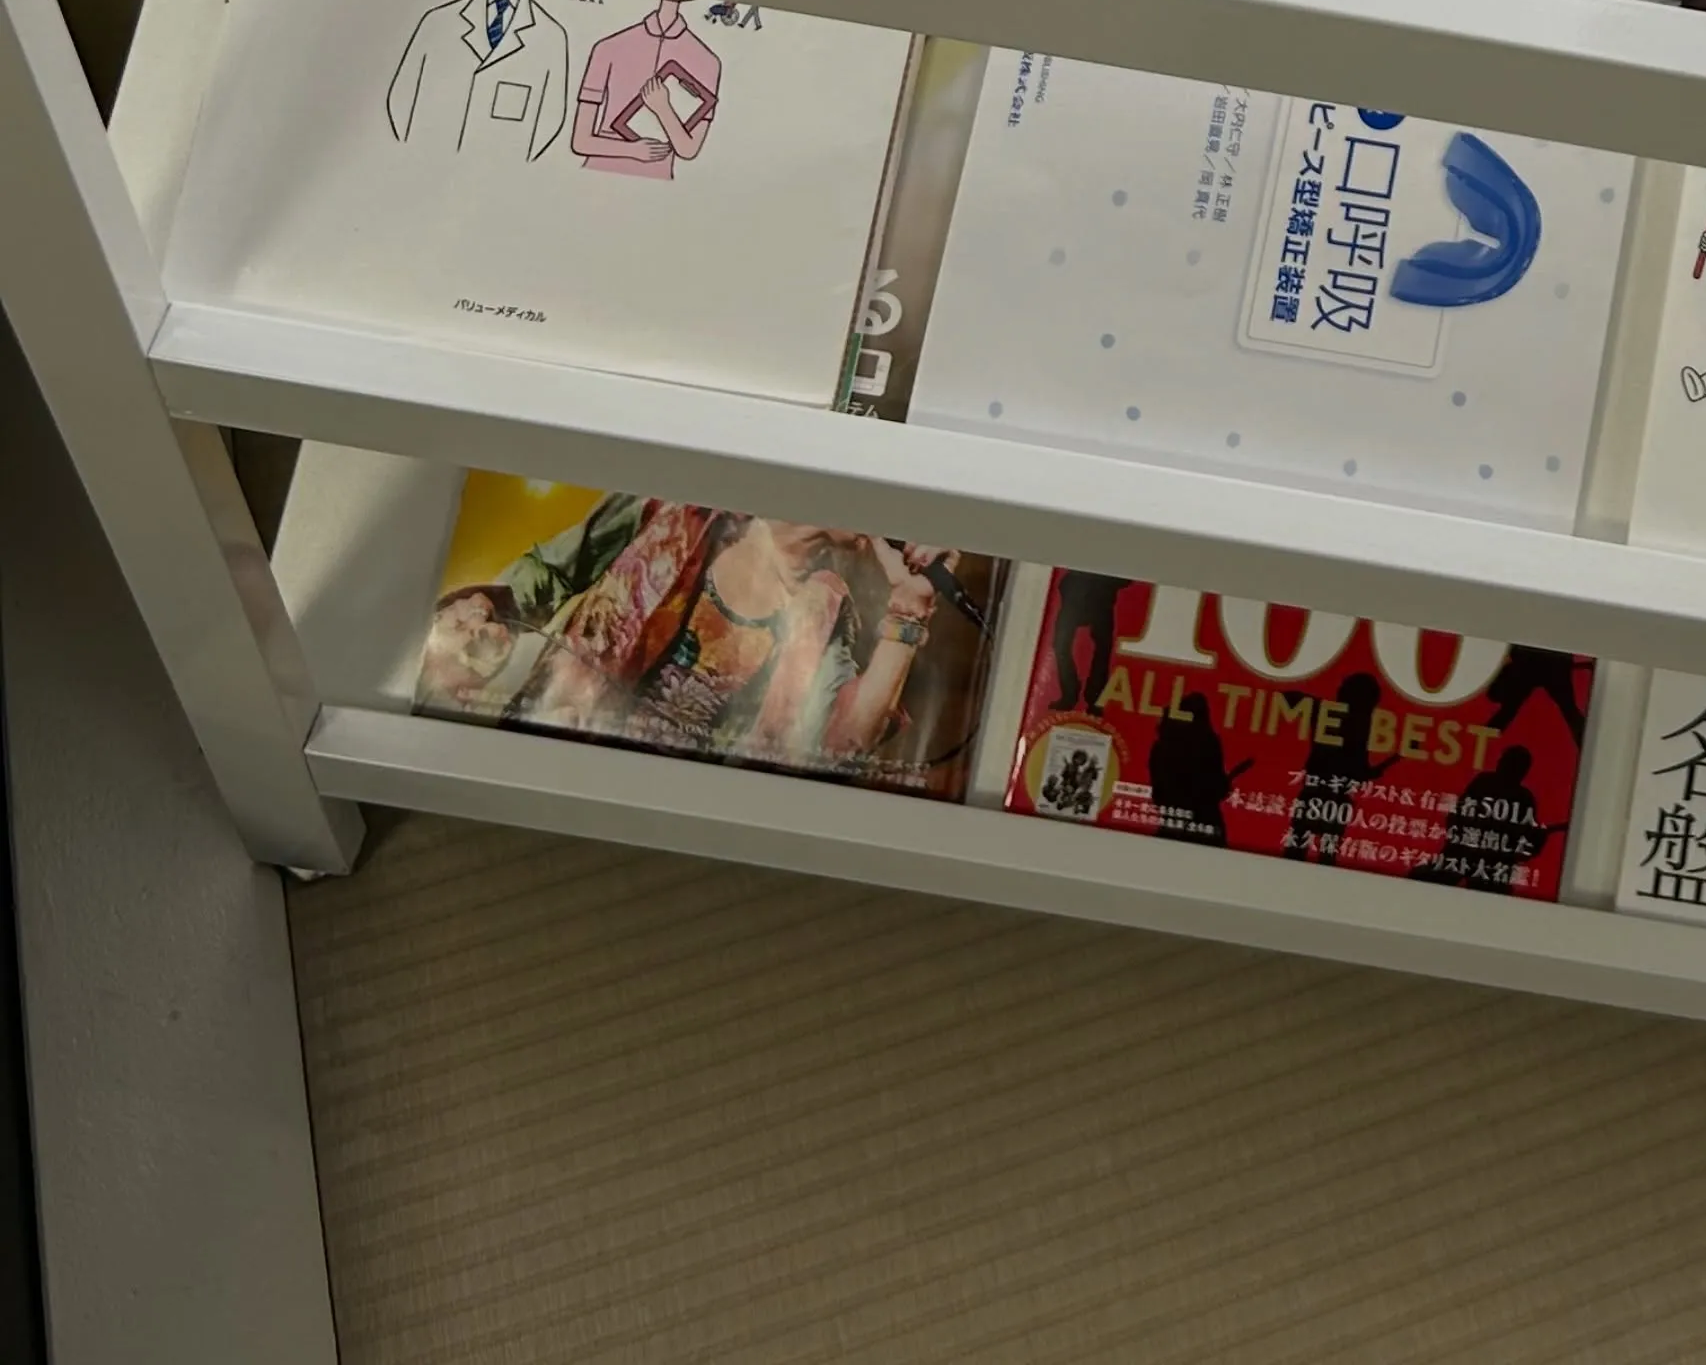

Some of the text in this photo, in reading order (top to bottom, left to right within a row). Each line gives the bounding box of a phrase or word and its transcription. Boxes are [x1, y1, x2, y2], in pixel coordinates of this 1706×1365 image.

[1310, 135, 1400, 333] 口呼吸
[454, 298, 548, 326] バリューメディカル
[1097, 666, 1502, 772] ALL TIME BEST
